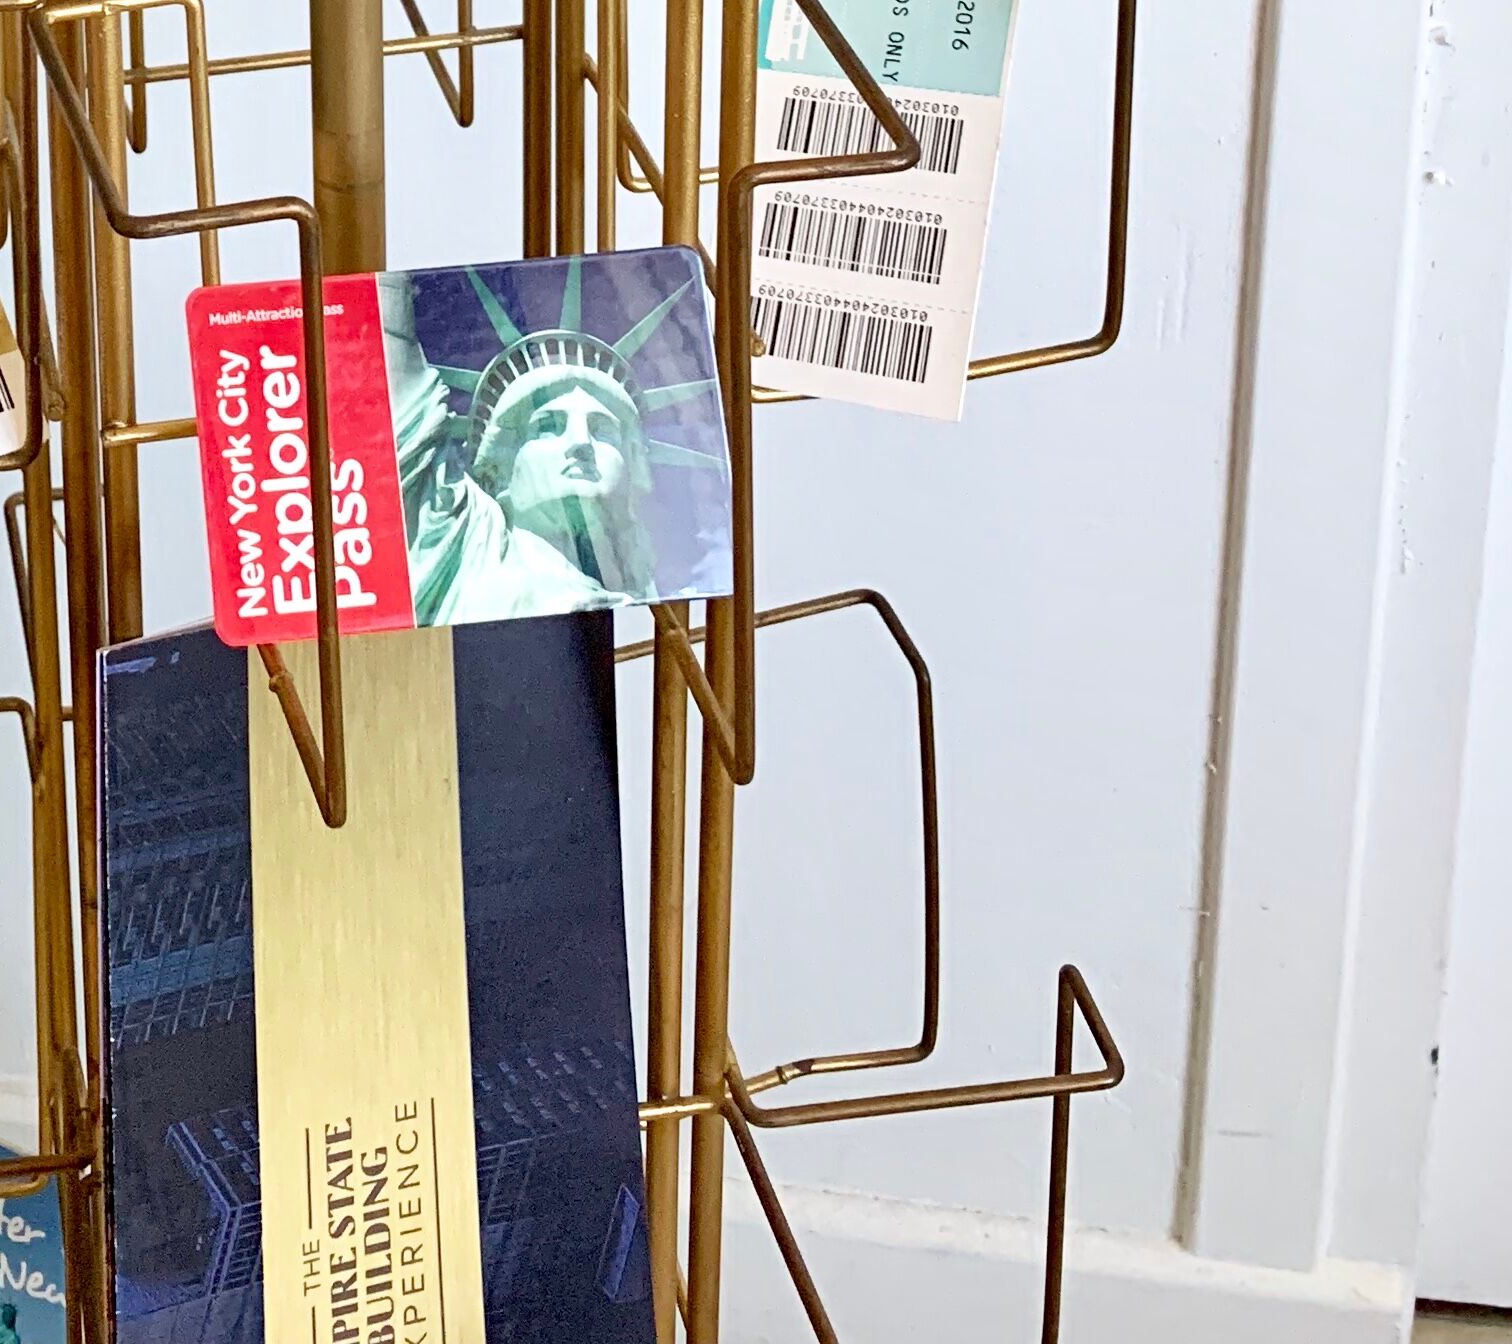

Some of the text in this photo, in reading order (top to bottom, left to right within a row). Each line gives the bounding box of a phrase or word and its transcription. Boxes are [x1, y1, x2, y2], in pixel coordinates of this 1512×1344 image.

[880, 30, 905, 82] ONLY
[208, 305, 304, 327] Multi-Attractio
[215, 349, 269, 619] New York City
[258, 344, 318, 615] Explorer
[302, 1238, 322, 1297] THE
[324, 1116, 360, 1344] PIRE STATE
[360, 1145, 396, 1344] BUILDING
